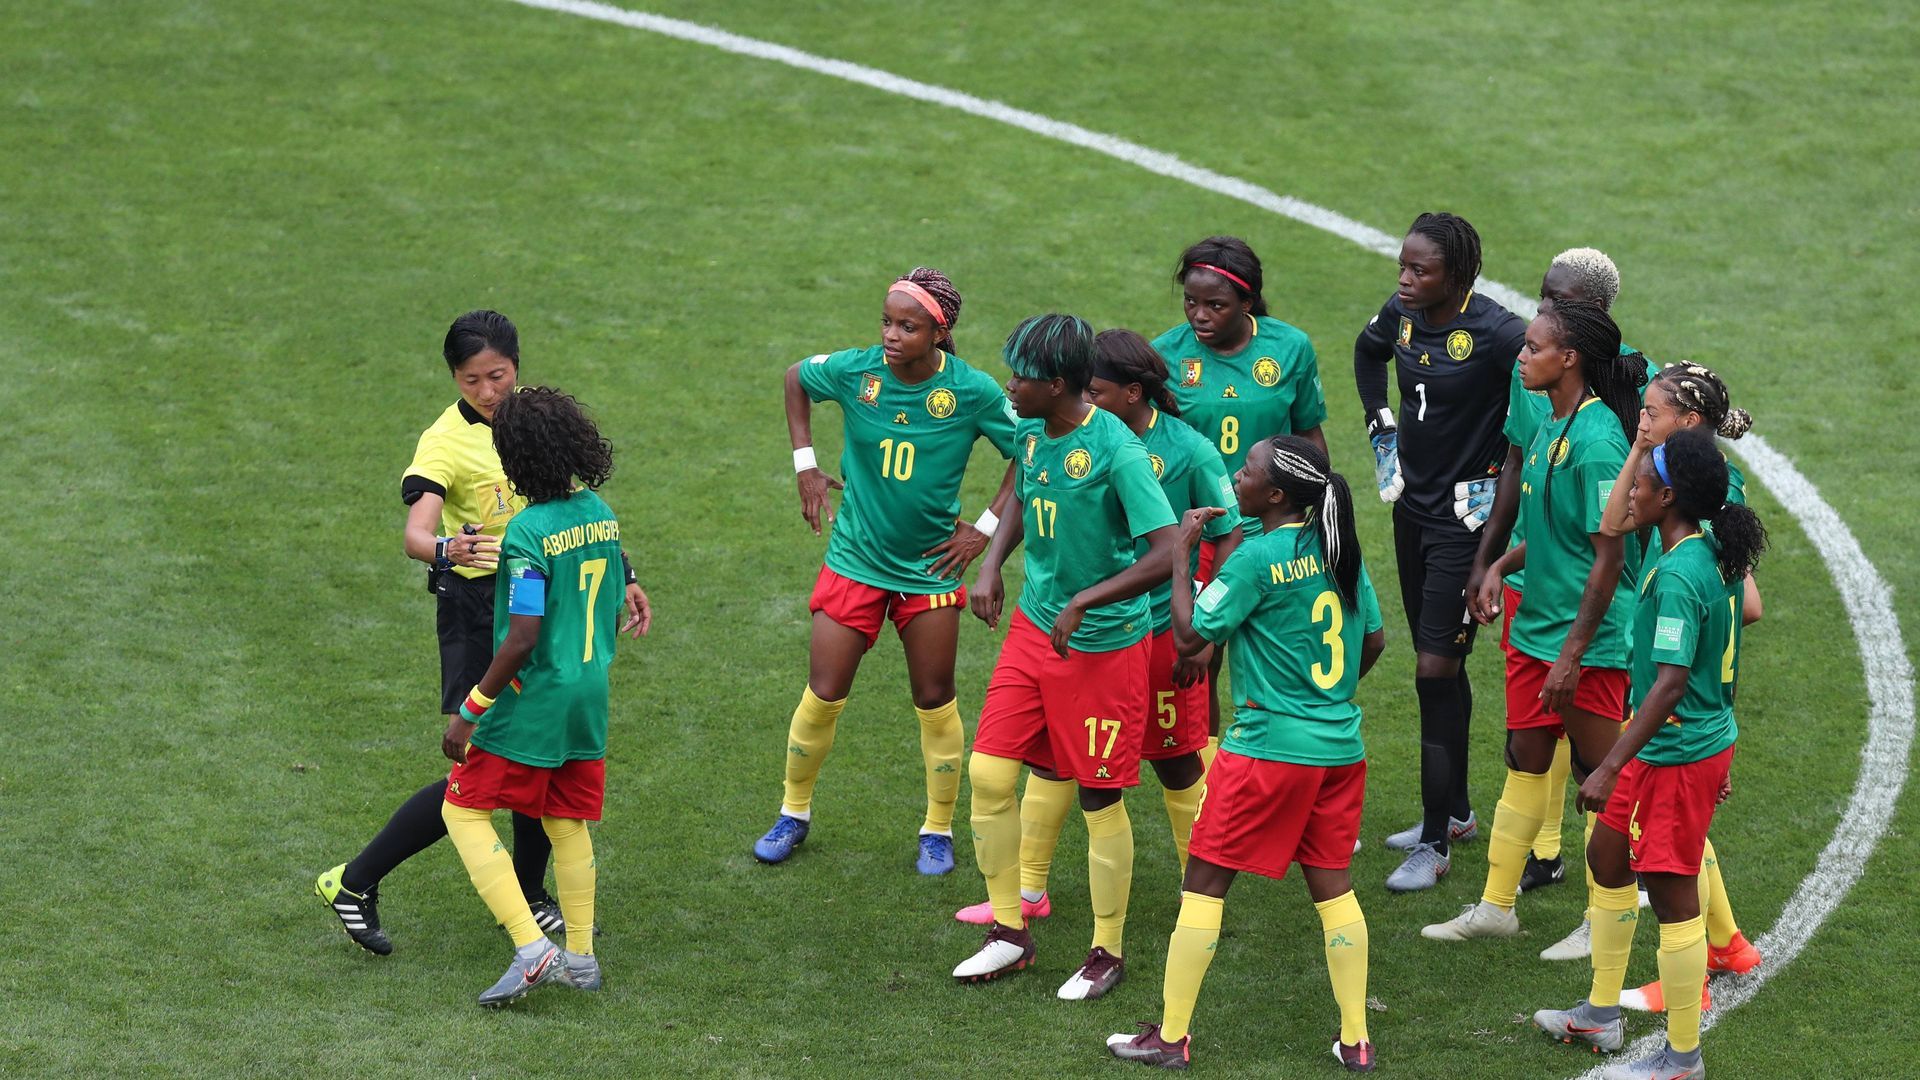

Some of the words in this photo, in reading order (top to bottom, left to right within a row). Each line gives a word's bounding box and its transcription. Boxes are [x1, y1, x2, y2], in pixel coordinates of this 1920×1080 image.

[1415, 383, 1427, 422] 1
[1220, 415, 1239, 455] 8
[879, 438, 915, 481] 10
[1032, 497, 1057, 539] 17
[542, 525, 584, 557] ABOUDI
[579, 558, 607, 663] 7
[1311, 590, 1345, 690] 3
[1157, 691, 1176, 729] 5
[1084, 717, 1121, 759] 17
[1629, 800, 1642, 841] 4
